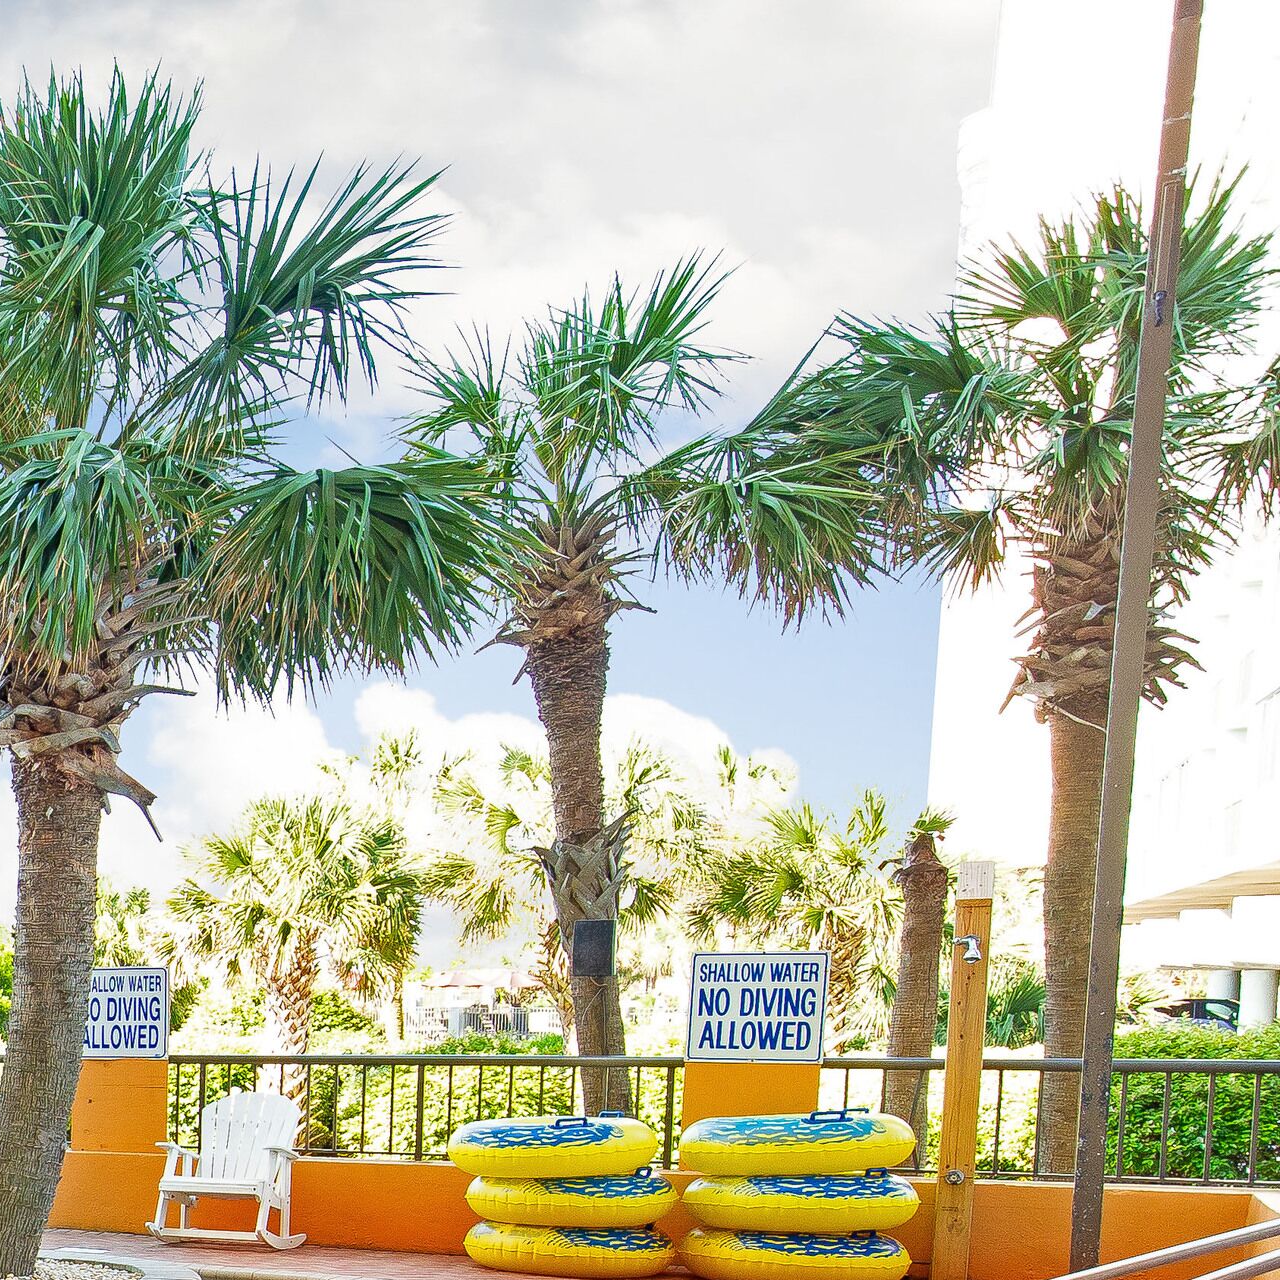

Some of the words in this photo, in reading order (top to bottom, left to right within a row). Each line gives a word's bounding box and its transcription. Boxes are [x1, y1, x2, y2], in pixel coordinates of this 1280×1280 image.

[92, 976, 125, 992] ALLOW
[129, 975, 162, 992] WATER
[700, 963, 765, 982] SHALLOW
[770, 963, 819, 982] WATER
[90, 997, 101, 1022] O
[107, 997, 160, 1021] DIVING
[698, 988, 730, 1016] NO
[740, 988, 817, 1017] DIVING
[83, 1025, 159, 1049] ALLOWED
[698, 1021, 812, 1050] ALLOWED
